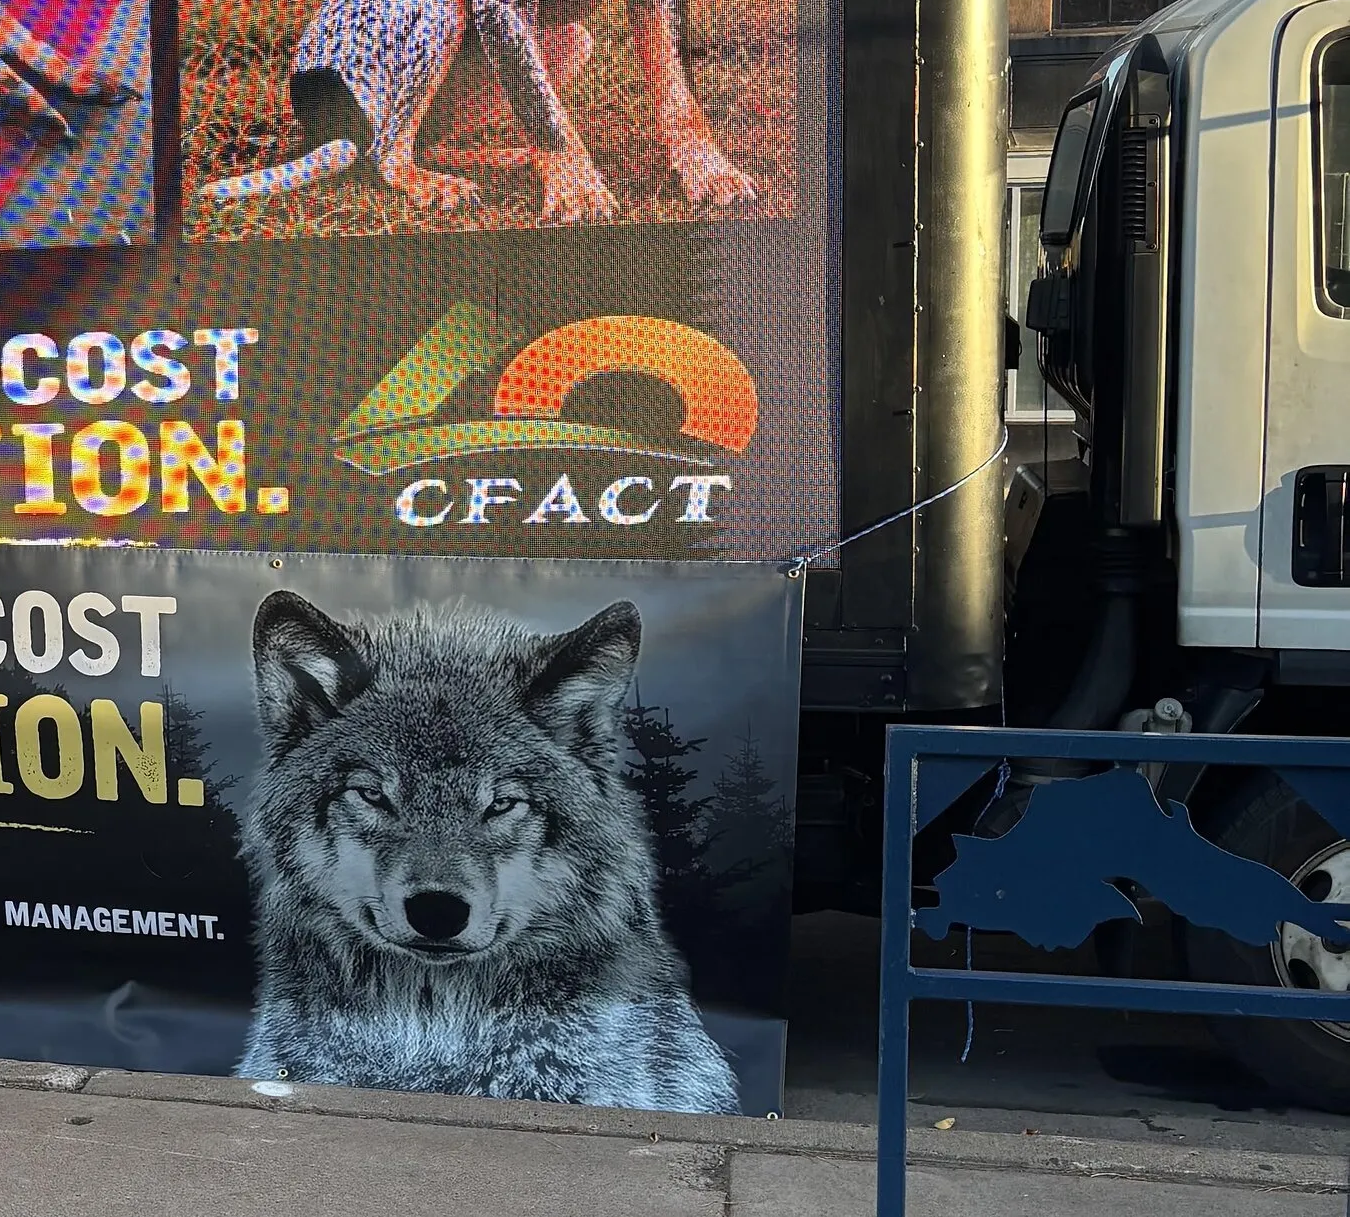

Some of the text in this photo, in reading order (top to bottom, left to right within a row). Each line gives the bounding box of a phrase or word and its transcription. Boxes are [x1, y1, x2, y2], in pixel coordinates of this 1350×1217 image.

[1, 327, 260, 405] COST
[393, 473, 733, 527] CFACT
[4, 900, 226, 940] MANAGEMENT.
